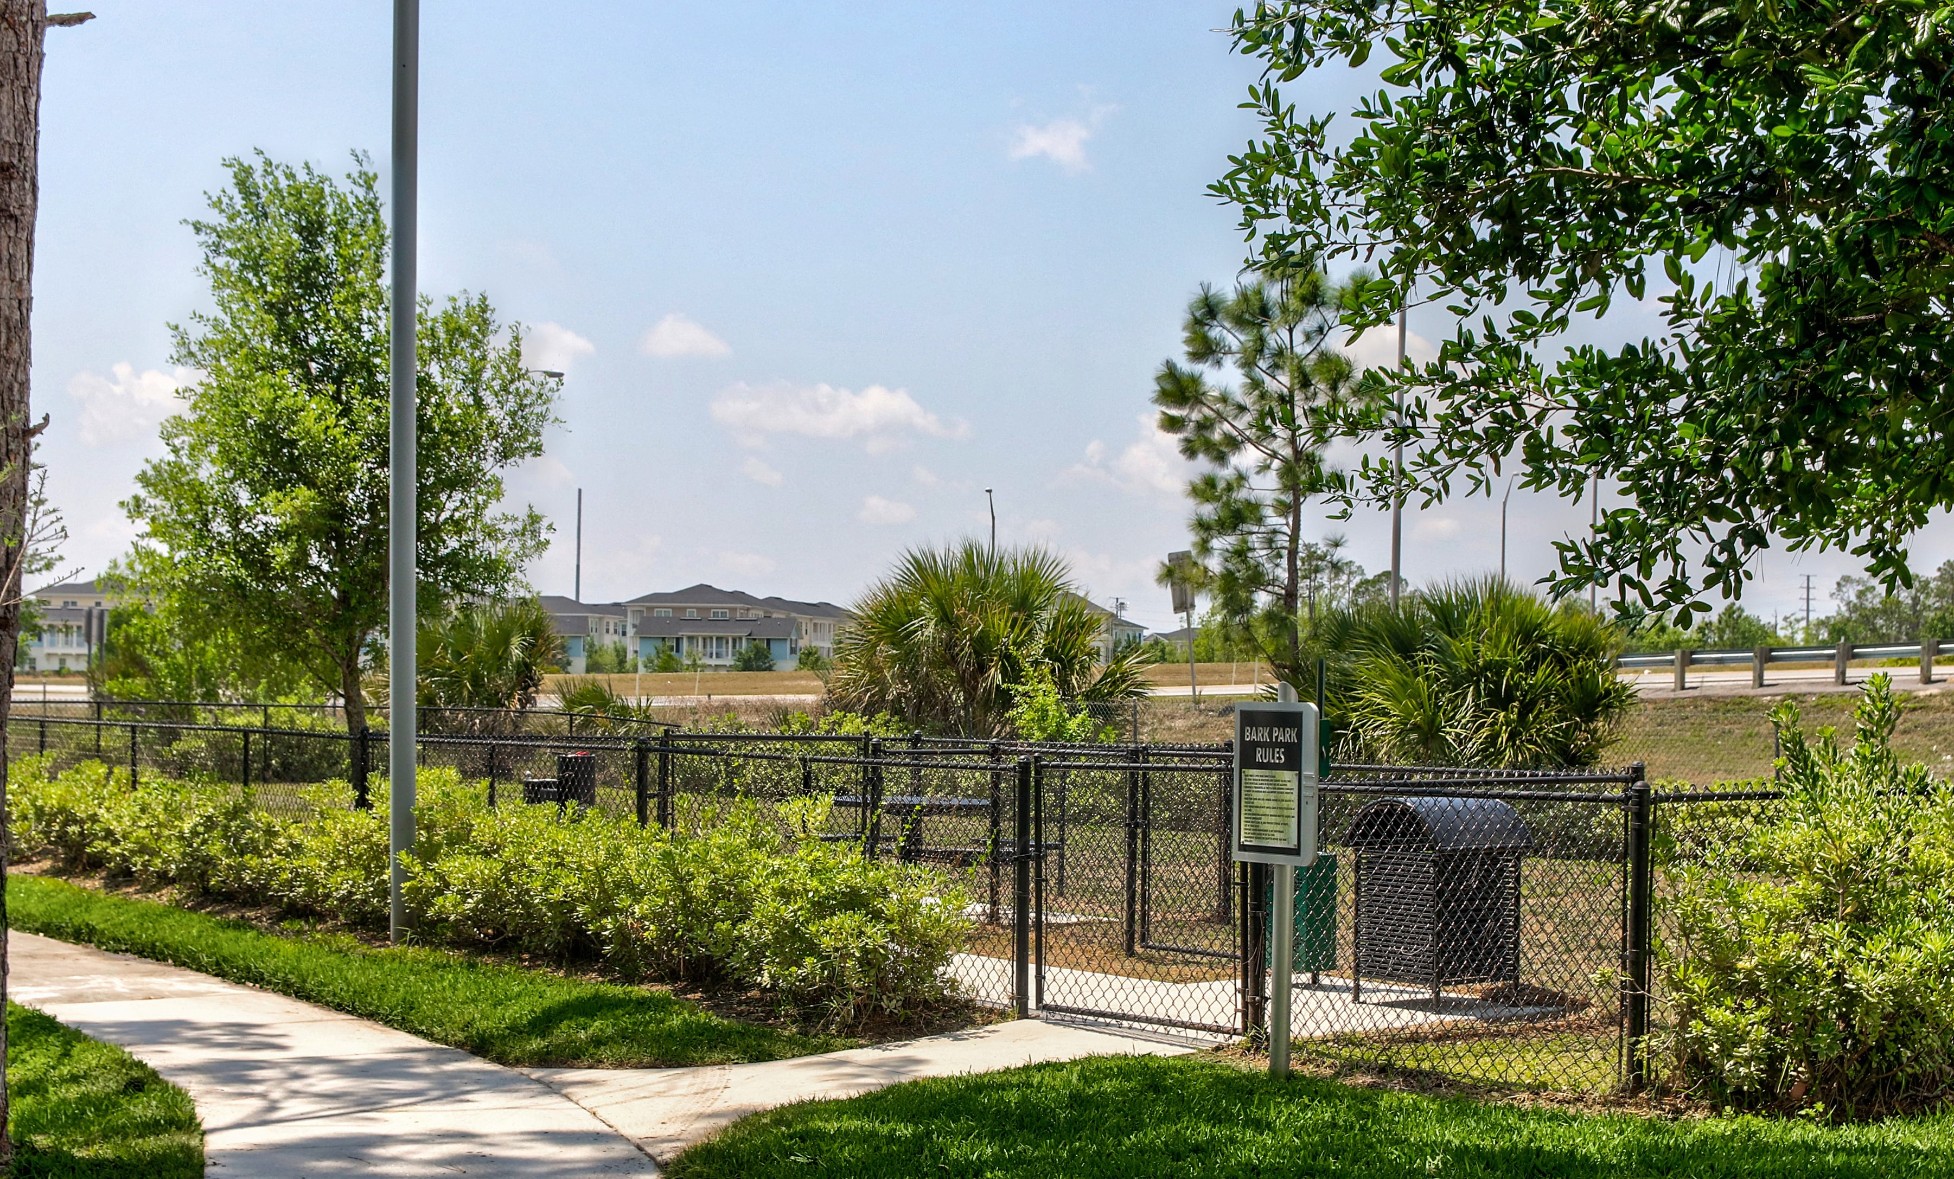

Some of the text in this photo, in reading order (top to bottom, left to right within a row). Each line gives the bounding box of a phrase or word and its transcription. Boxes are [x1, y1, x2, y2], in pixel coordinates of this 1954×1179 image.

[1245, 726, 1298, 743] BARK PARK
[1255, 747, 1285, 764] RULES
